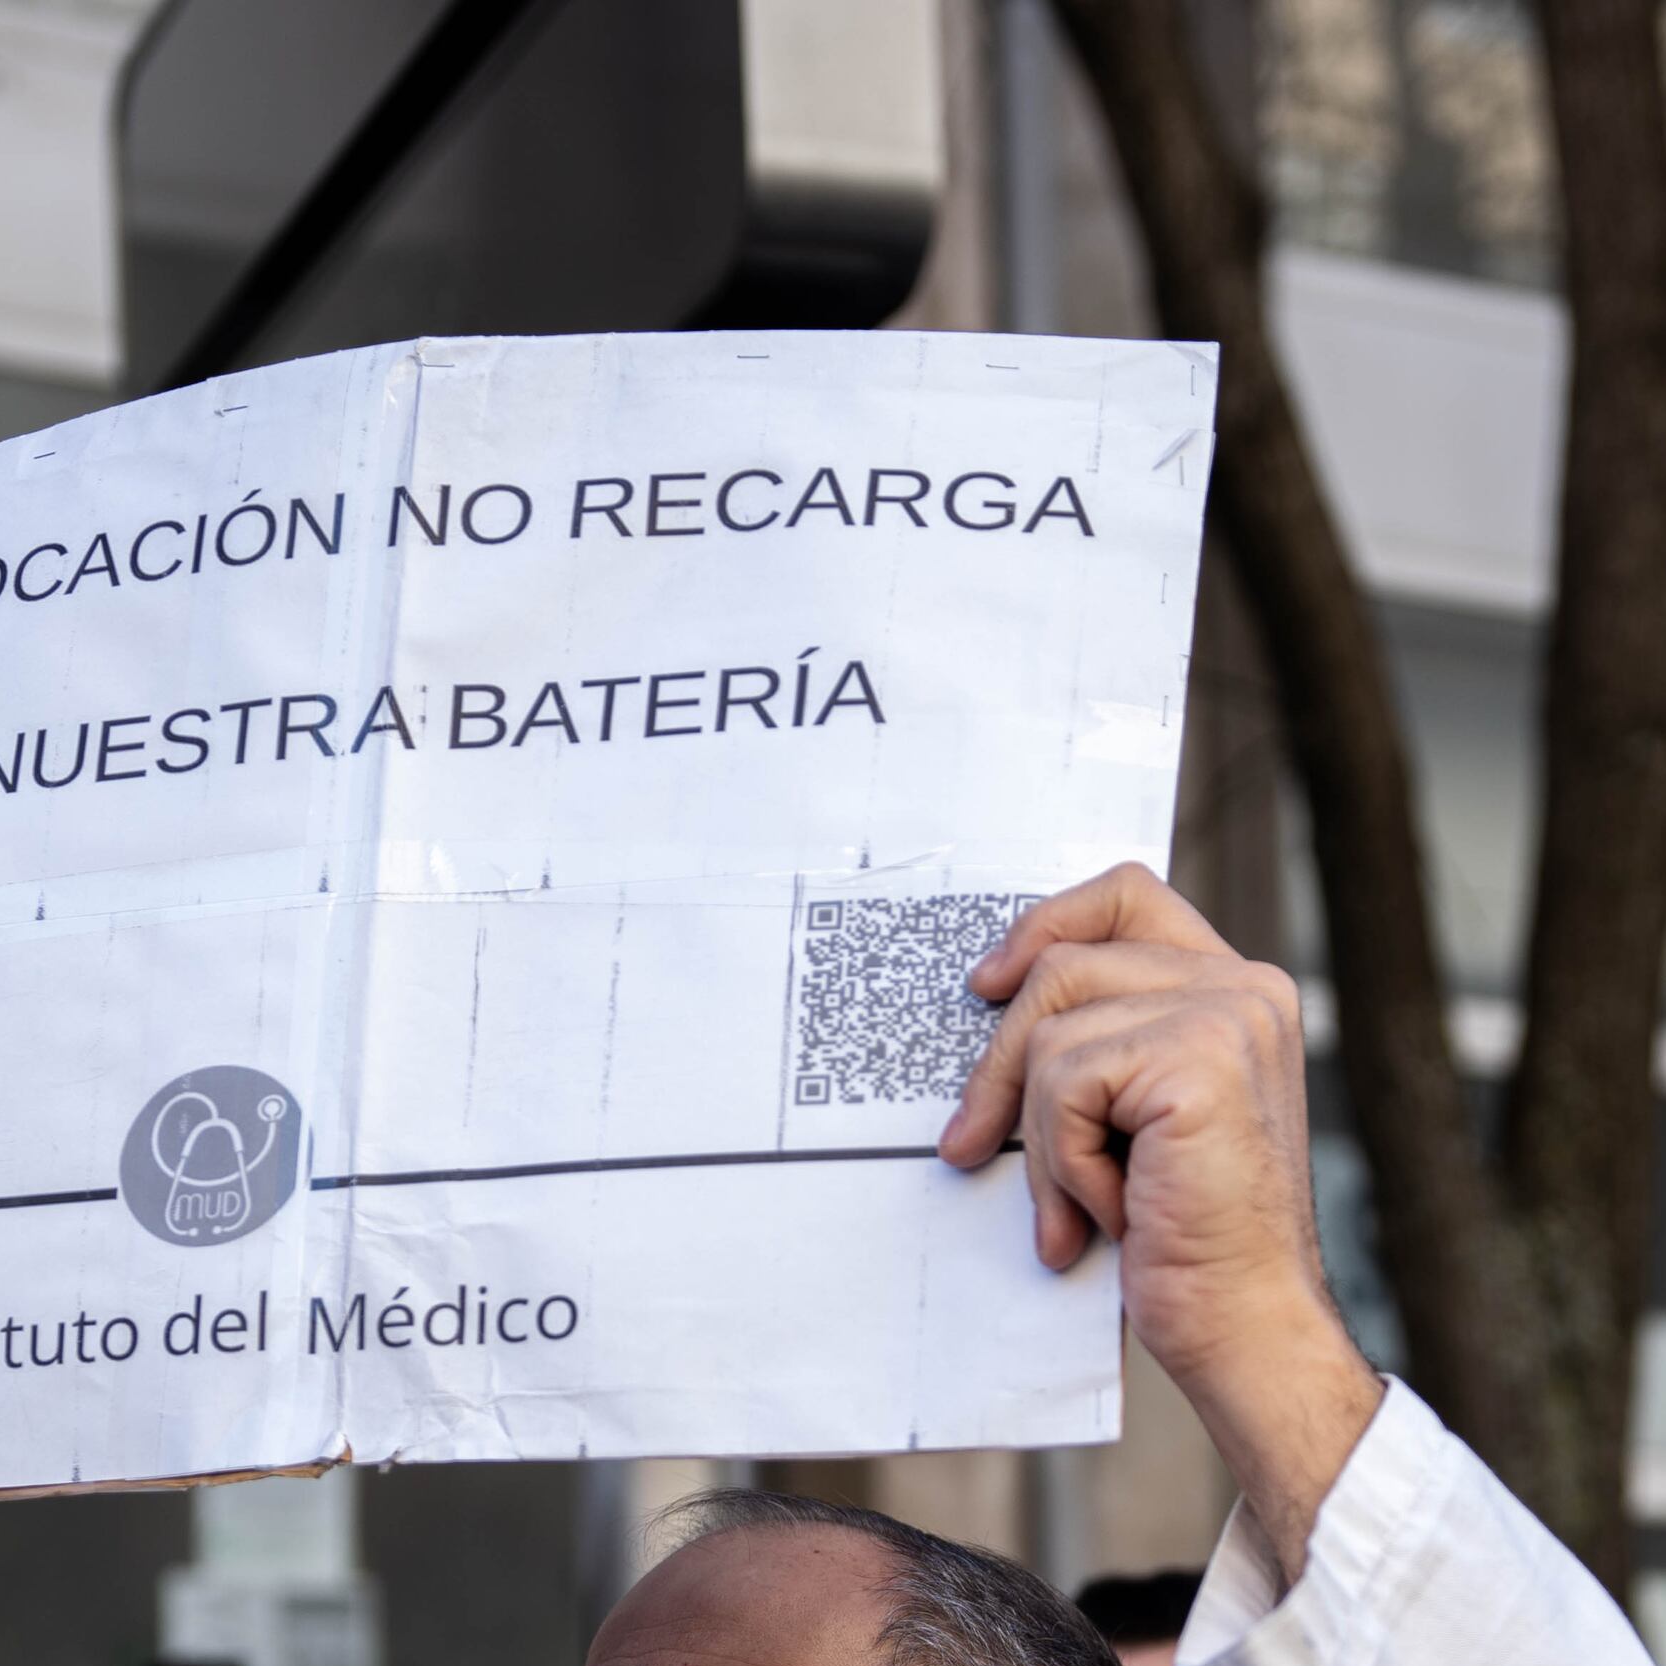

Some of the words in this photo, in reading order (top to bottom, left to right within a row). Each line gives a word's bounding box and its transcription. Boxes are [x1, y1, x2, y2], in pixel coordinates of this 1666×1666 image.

[387, 483, 533, 548] NO
[569, 467, 1096, 540] RECARGA
[448, 646, 886, 750] BATERÍA
[163, 1290, 268, 1357] del
[308, 1284, 579, 1355] Médico
